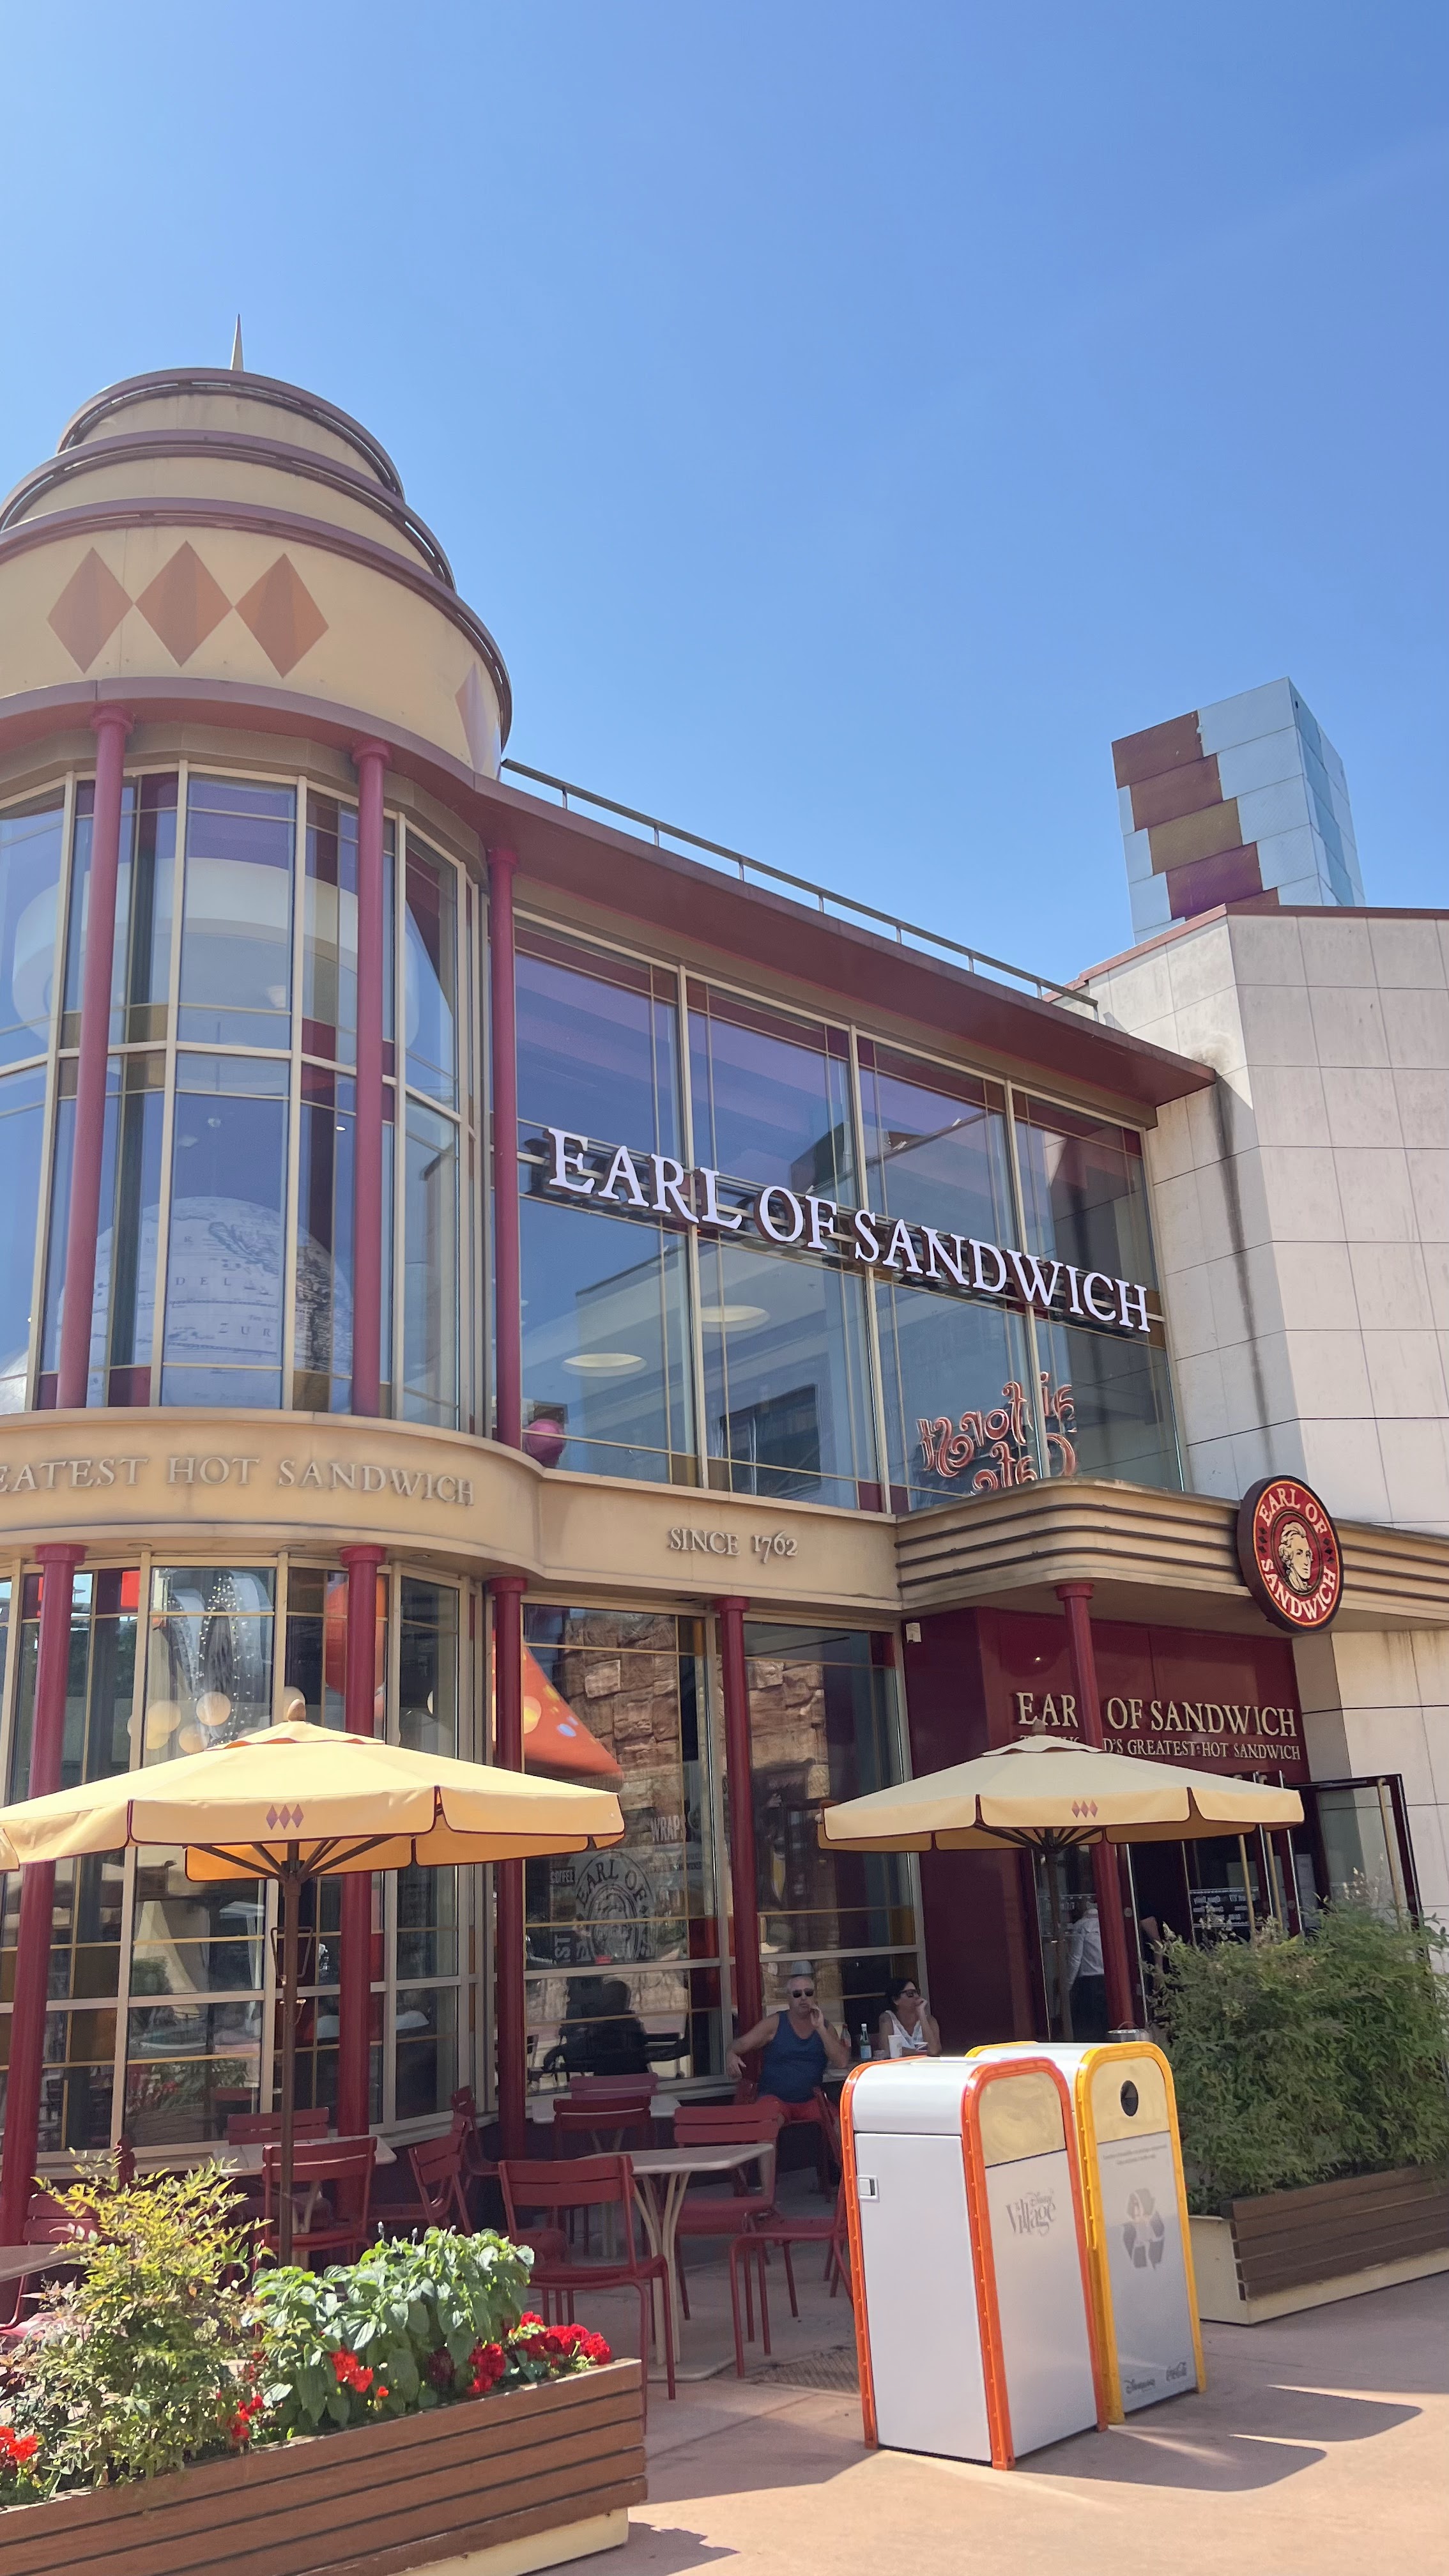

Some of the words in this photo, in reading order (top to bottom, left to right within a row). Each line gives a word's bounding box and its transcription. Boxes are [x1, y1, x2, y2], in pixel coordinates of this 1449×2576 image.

[548, 1127, 742, 1230] EARL
[760, 1185, 837, 1251] OF
[854, 1209, 1151, 1332] SANDWICH
[167, 1456, 261, 1485] HOT
[278, 1459, 475, 1506] SANDWICH
[1259, 1487, 1301, 1527] EARL
[1305, 1502, 1328, 1534] OF
[670, 1528, 741, 1556] SINCE
[753, 1530, 799, 1565] 1762
[1261, 1558, 1337, 1620] SANDWICH
[1015, 1691, 1079, 1728] EAR
[1107, 1697, 1143, 1729] OF
[1150, 1699, 1298, 1737] SANDWICH
[1127, 1738, 1197, 1758] GREATEST
[1201, 1741, 1229, 1758] HOT
[1233, 1742, 1301, 1761] SANDWICH
[576, 1859, 619, 1909] EARL
